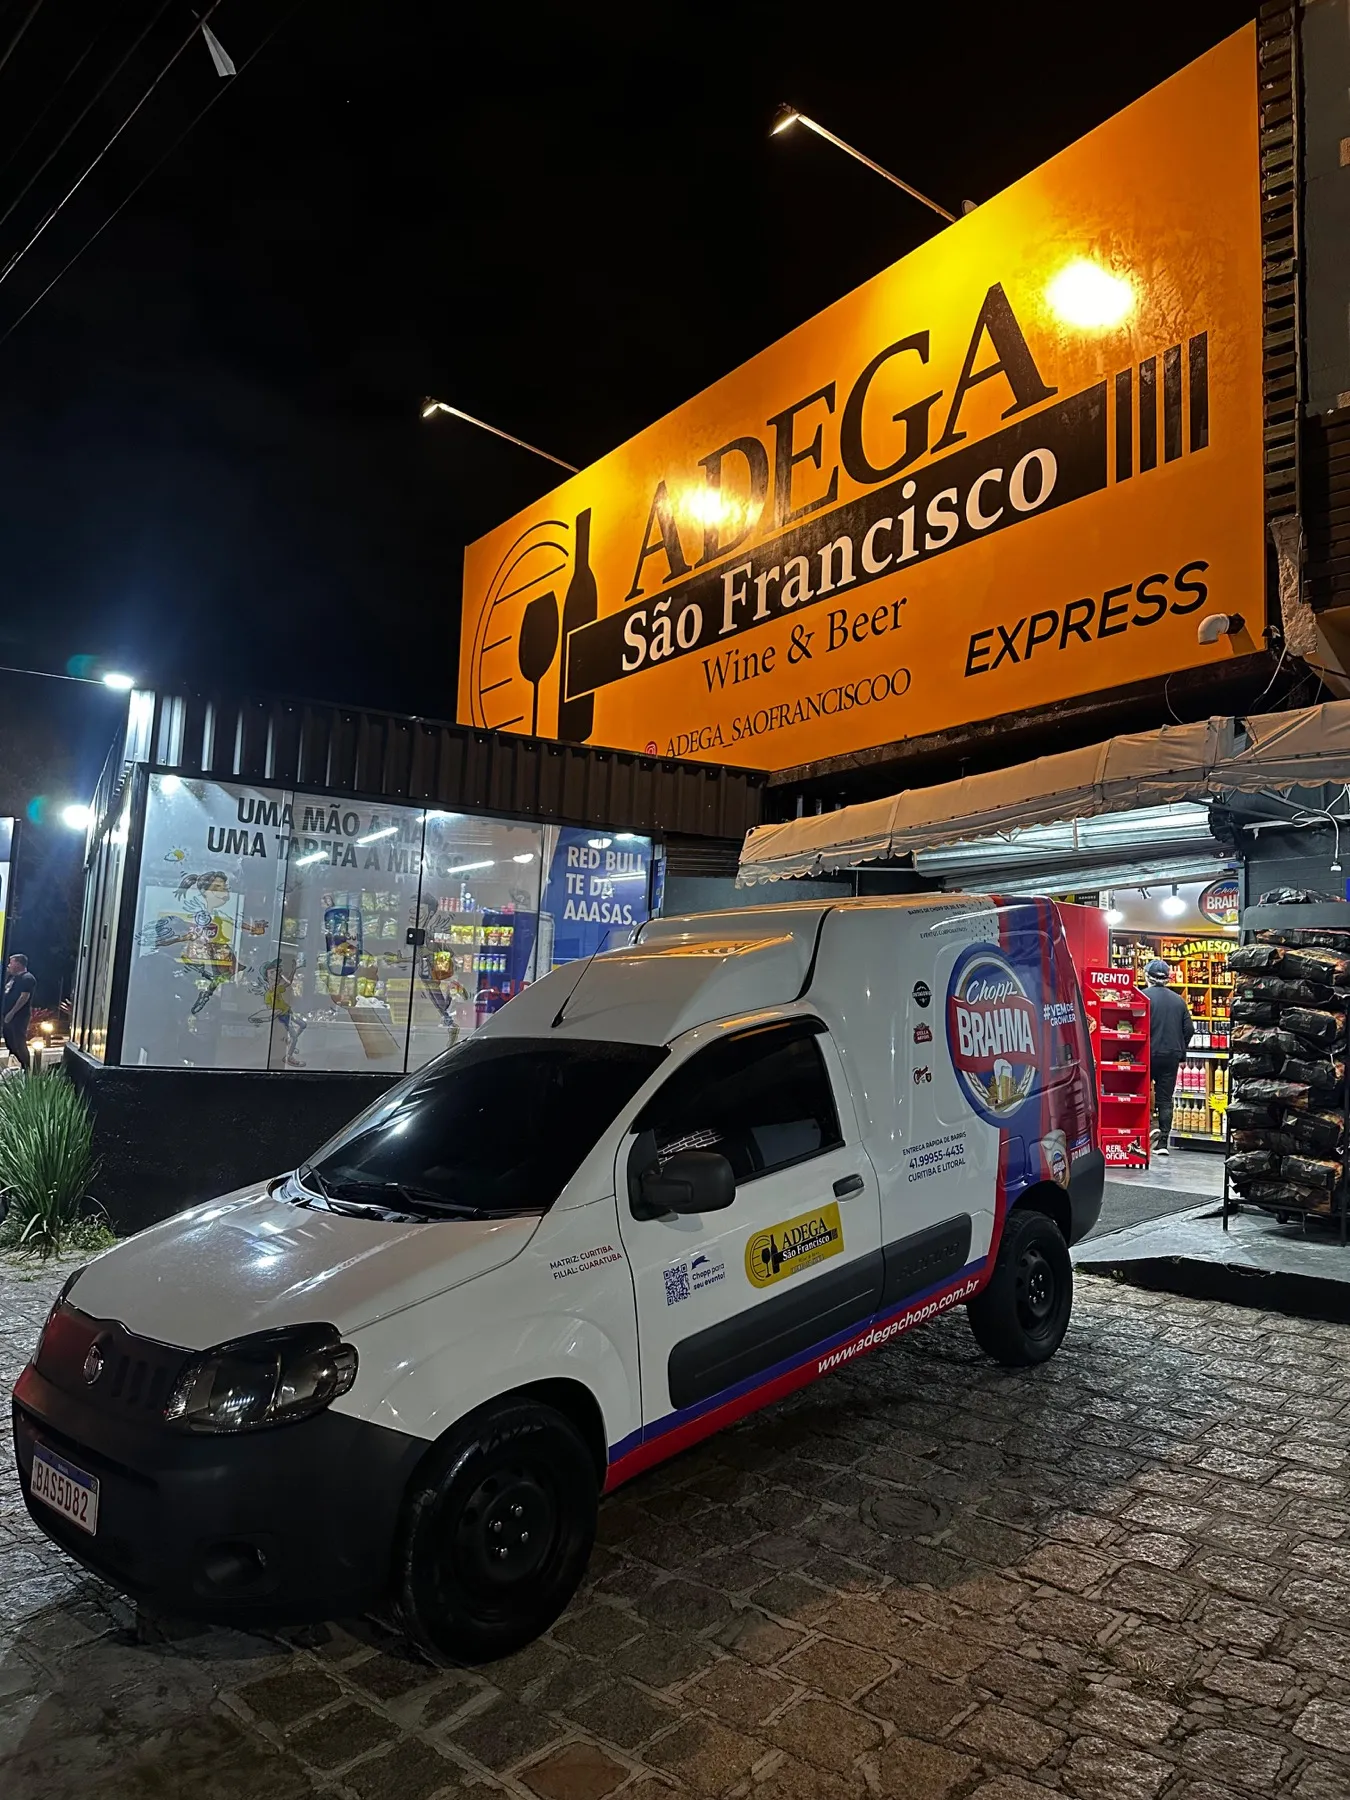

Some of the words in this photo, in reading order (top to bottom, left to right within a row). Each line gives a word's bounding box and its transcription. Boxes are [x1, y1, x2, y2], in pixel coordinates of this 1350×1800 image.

[625, 281, 1058, 602] ADEGA
[621, 597, 702, 671] São
[719, 447, 1058, 635] Francisco
[964, 560, 1210, 678] EXPRESS
[702, 645, 776, 694] Wine
[787, 624, 815, 664] &
[825, 597, 907, 653] Beer
[665, 667, 911, 758] ADEGA_SAOFRANCISCOO
[237, 797, 295, 830] UMA
[302, 804, 360, 837] MÃO
[207, 826, 267, 858] UMA
[275, 834, 358, 869] TAREFA
[364, 847, 381, 871] A
[567, 846, 601, 869] RED
[606, 851, 646, 873] BULL
[566, 873, 585, 895] TE
[563, 899, 637, 926] AAASAS.
[1206, 895, 1238, 910] BRAH
[1182, 940, 1240, 955] JAMESON
[966, 979, 1017, 1005] Chopp
[1090, 972, 1130, 986] TRENTO
[956, 1006, 1035, 1058] BRAHMA
[1050, 1013, 1076, 1026] GROWLER
[902, 1144, 926, 1156] ENTREGA
[926, 1139, 944, 1149] RAPIDA
[950, 1131, 966, 1142] BARRIS
[909, 1144, 964, 1169] 41.99955-4435
[1106, 1144, 1122, 1152] REAL
[908, 1167, 936, 1182] CURITIBA
[938, 1164, 942, 1173] E
[942, 1158, 966, 1172] LITORAL
[782, 1217, 828, 1250] ADEGA
[550, 1255, 580, 1270] MATRIZ:
[580, 1244, 614, 1261] CURITIBA
[782, 1247, 796, 1261] São
[797, 1235, 830, 1255] Francisco
[553, 1266, 579, 1280] FILIAL:
[578, 1252, 622, 1272] GUARATUBA
[692, 1270, 711, 1282] Chopp
[712, 1263, 725, 1276] para
[694, 1281, 704, 1290] seu
[704, 1272, 726, 1287] evento!
[818, 1279, 979, 1374] www.adegachopp.com.br
[36, 1464, 89, 1522] BAS5D82
